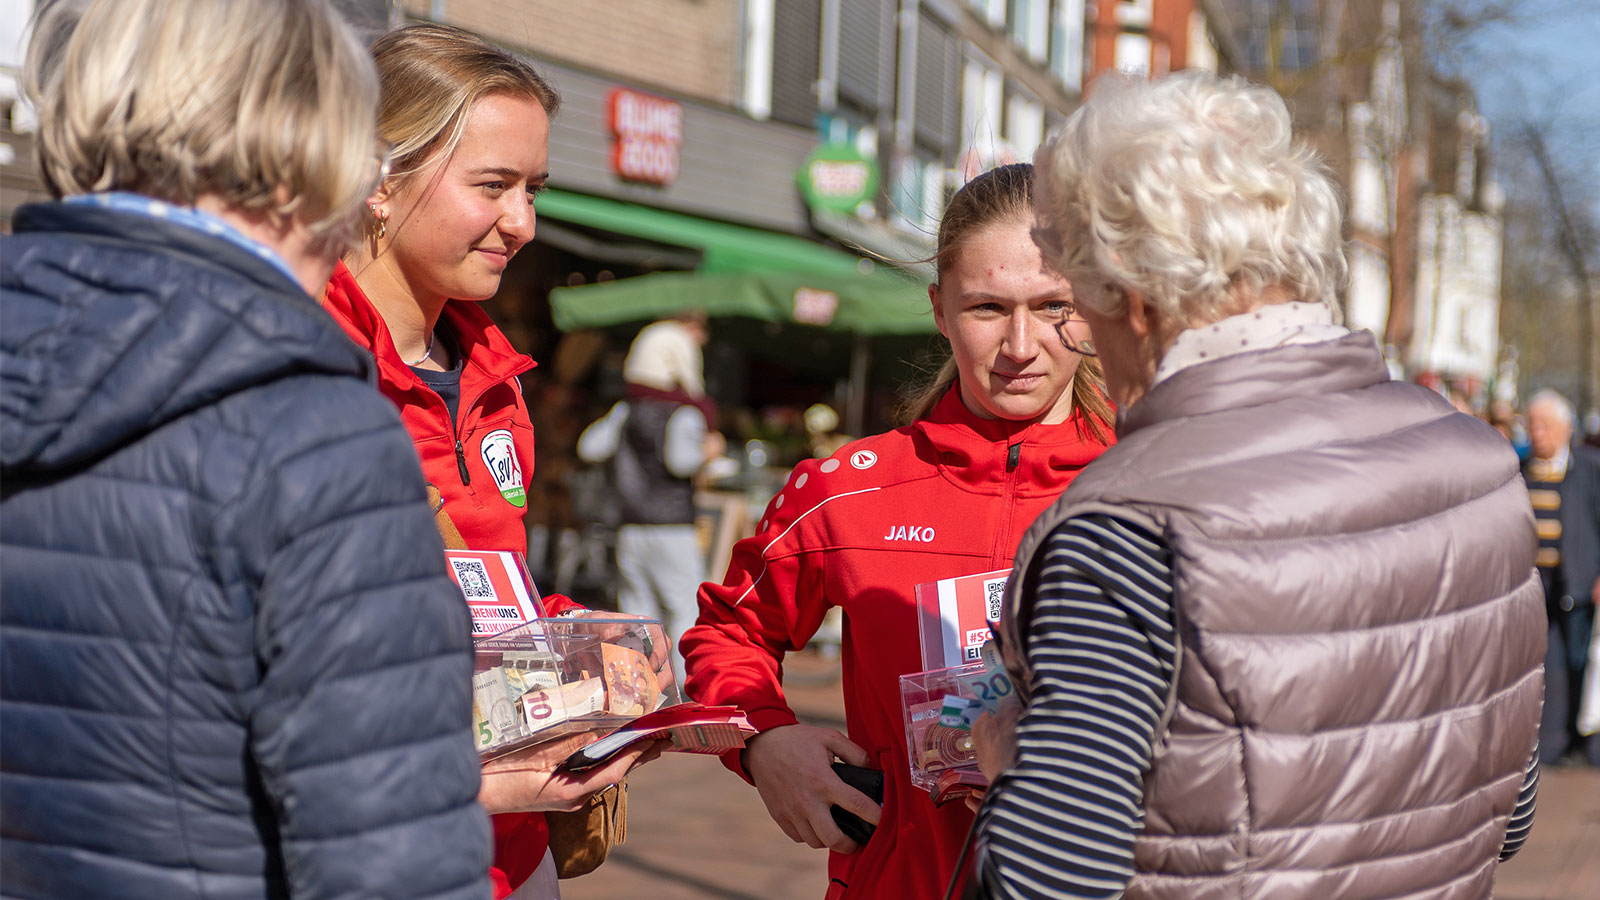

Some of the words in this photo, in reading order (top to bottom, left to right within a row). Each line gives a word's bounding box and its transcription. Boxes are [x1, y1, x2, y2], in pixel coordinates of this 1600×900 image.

[884, 525, 935, 543] JAKO
[971, 673, 1011, 700] 20
[527, 691, 553, 720] 10
[478, 720, 493, 745] 5
